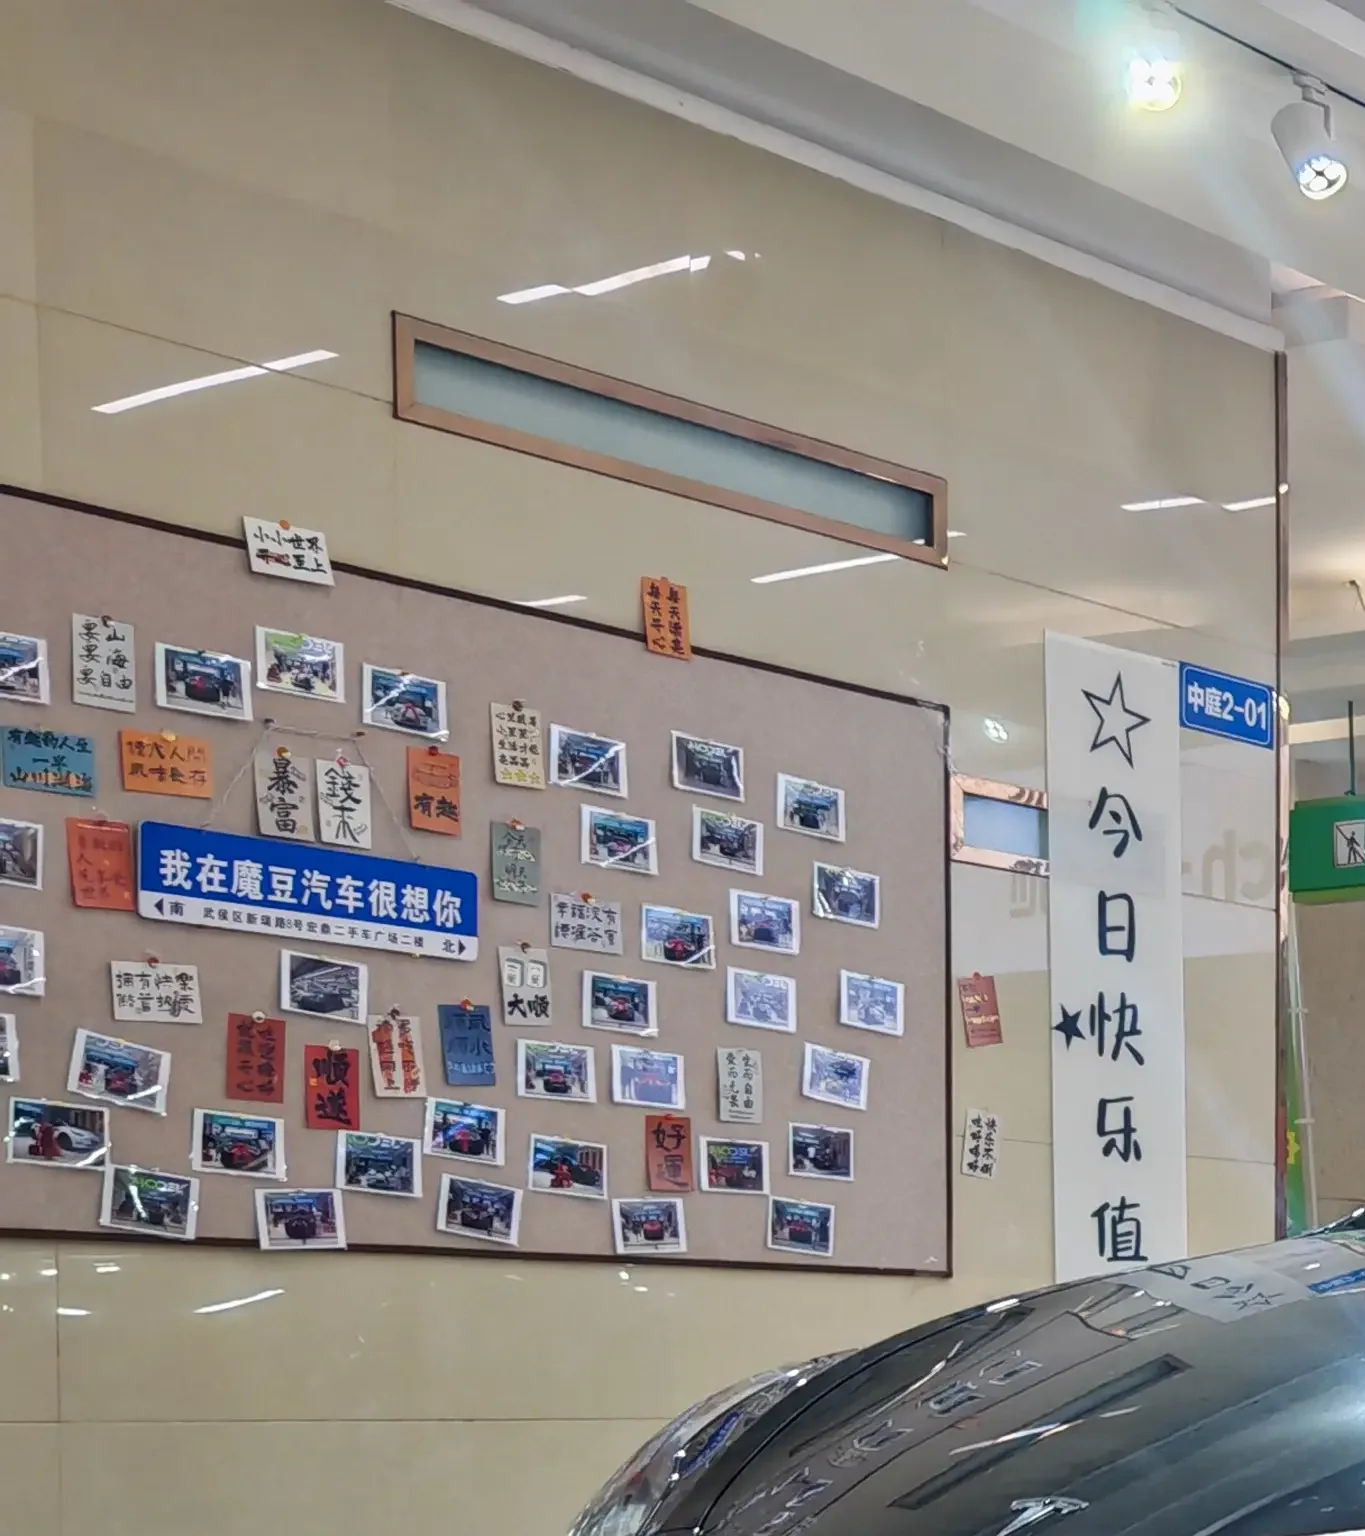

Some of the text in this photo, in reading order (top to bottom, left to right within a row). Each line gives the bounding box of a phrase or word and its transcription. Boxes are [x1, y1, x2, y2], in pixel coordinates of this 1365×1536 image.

[1187, 681, 1267, 731] 中庭2-01
[267, 757, 299, 834] 暴富
[159, 848, 464, 929] 我在魔豆汽车很想你
[1088, 786, 1149, 1263] 今日快乐值
